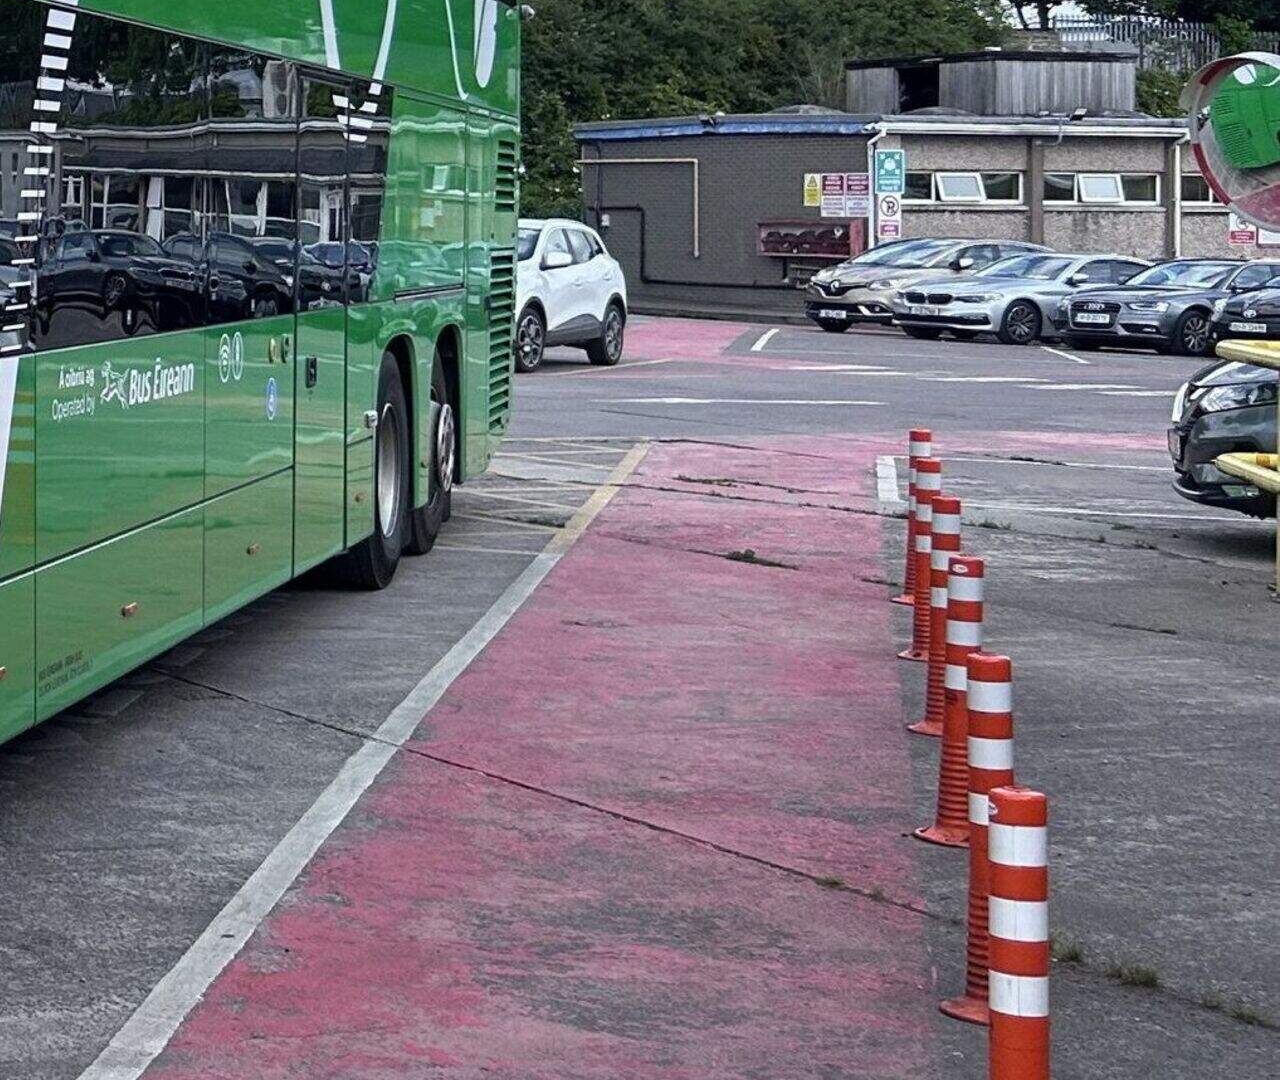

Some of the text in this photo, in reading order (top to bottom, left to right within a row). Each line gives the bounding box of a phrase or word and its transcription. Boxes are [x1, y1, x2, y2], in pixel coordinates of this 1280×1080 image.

[128, 357, 195, 406] Bus Éireann
[52, 392, 96, 422] Operated by
